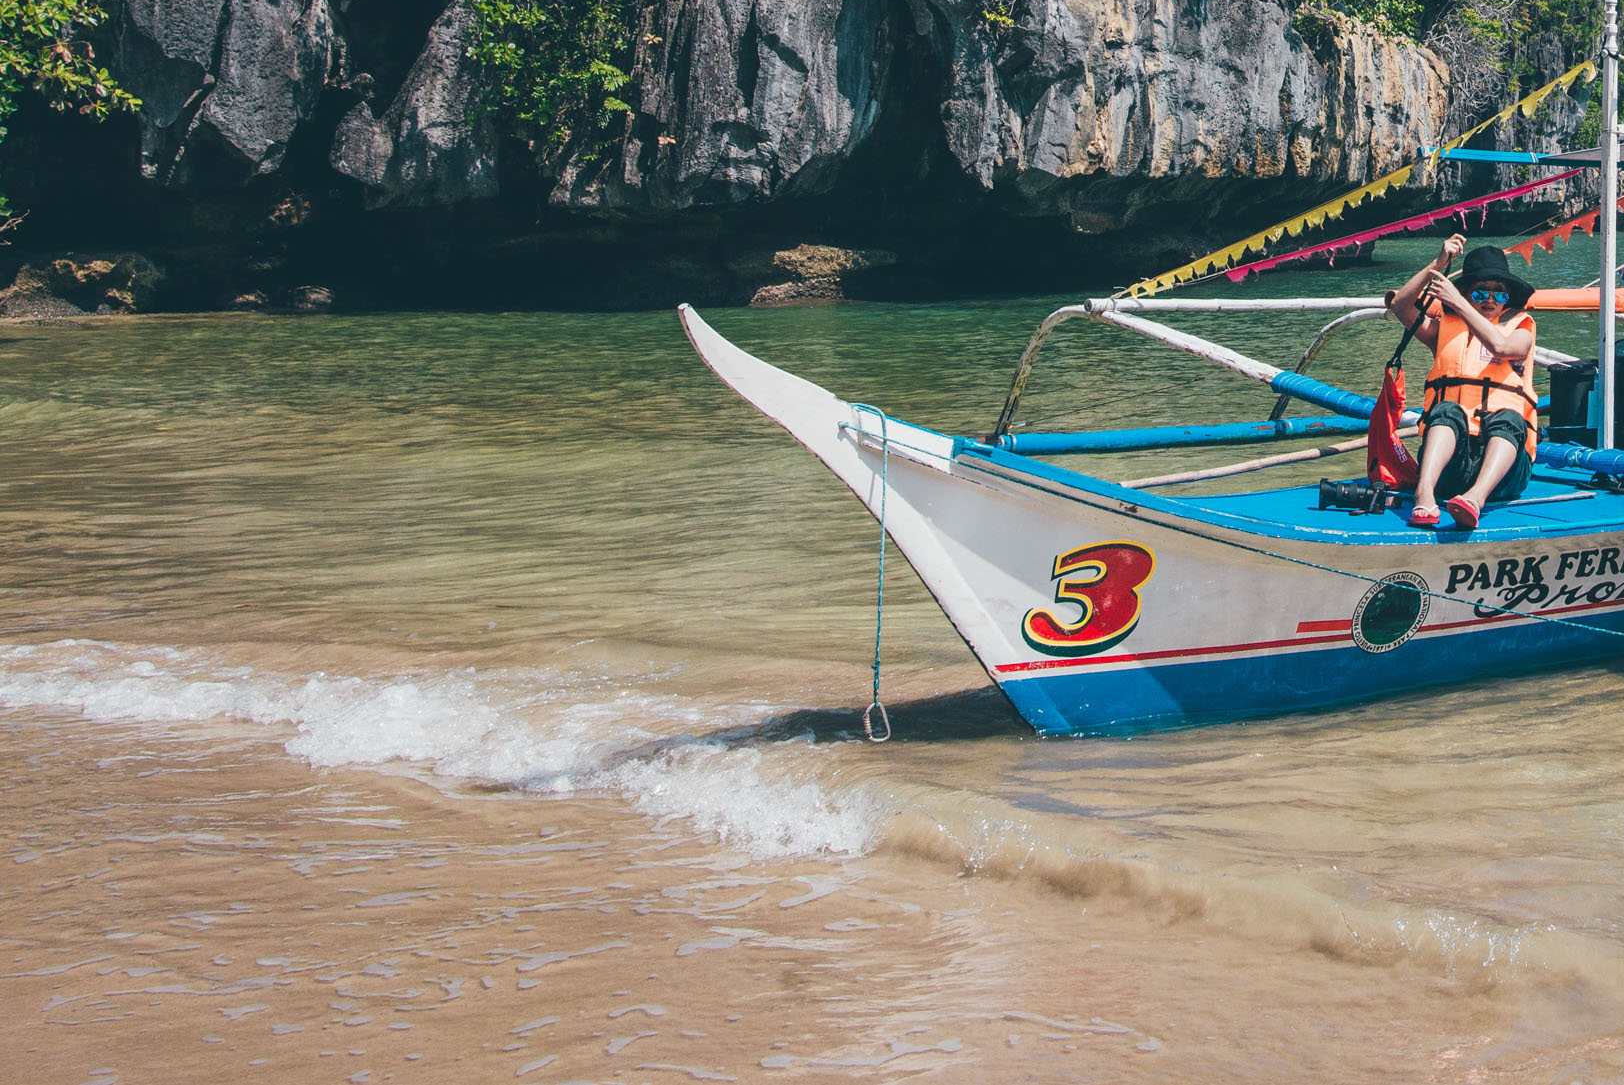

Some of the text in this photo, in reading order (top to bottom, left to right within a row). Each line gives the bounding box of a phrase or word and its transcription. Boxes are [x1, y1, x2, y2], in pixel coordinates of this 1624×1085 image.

[1370, 574, 1417, 596] SUBERRANEAN
[1445, 555, 1549, 594] PARK
[1021, 540, 1156, 657] 3
[1353, 596, 1370, 631] PRINCESA
[1410, 597, 1428, 633] NATIONAL
[1355, 631, 1370, 651] PUERTO
[1393, 633, 1410, 647] PARK
